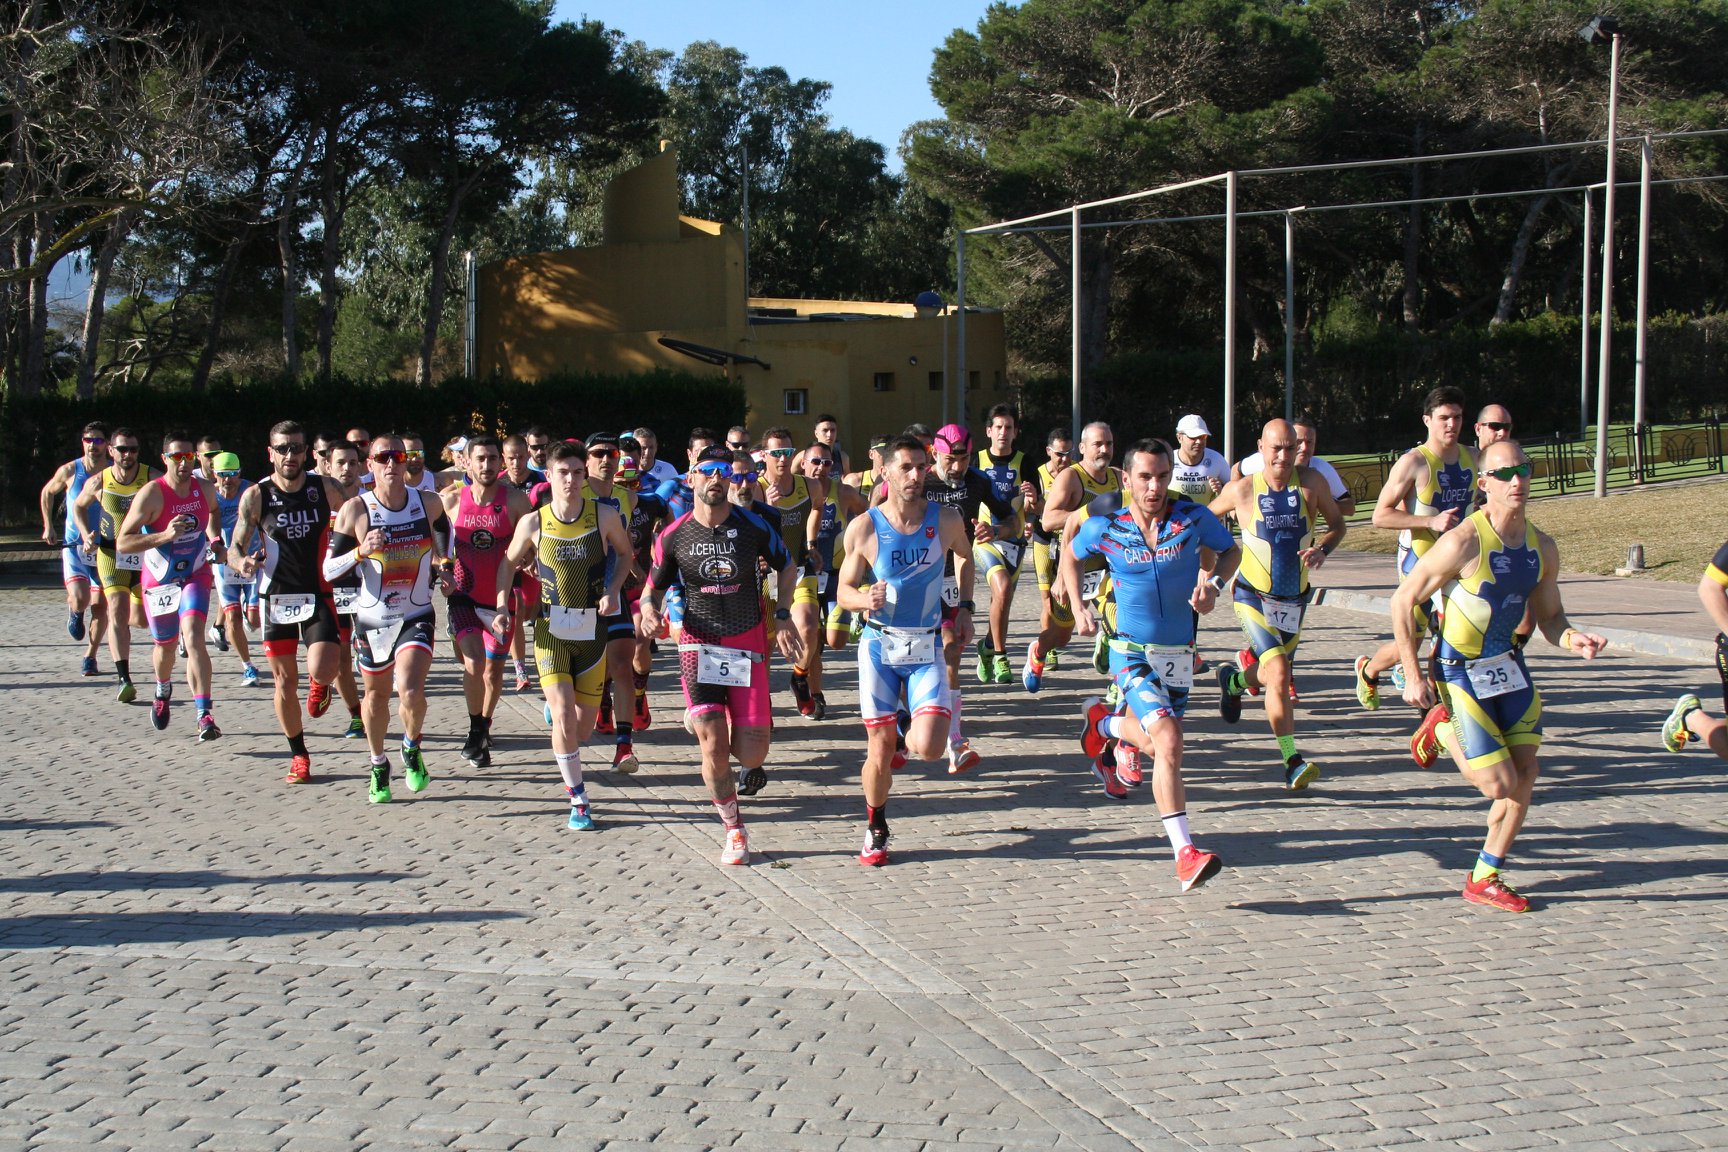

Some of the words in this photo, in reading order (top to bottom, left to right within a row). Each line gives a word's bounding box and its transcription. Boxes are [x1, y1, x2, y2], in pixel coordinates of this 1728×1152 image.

[276, 508, 320, 528] SULI
[463, 514, 500, 528] HASSAN
[286, 524, 311, 540] ESP
[126, 555, 140, 565] 43
[890, 547, 932, 568] RUIZ
[1123, 542, 1182, 564] CALDERAY
[944, 586, 960, 600] 19
[1082, 581, 1097, 595] 27
[158, 595, 173, 608] 42
[335, 597, 350, 608] 26
[284, 605, 301, 618] 50
[1272, 610, 1289, 624] 17
[904, 641, 912, 656] 1
[719, 661, 730, 677] 5
[1165, 661, 1175, 677] 2
[1485, 667, 1508, 686] 25
